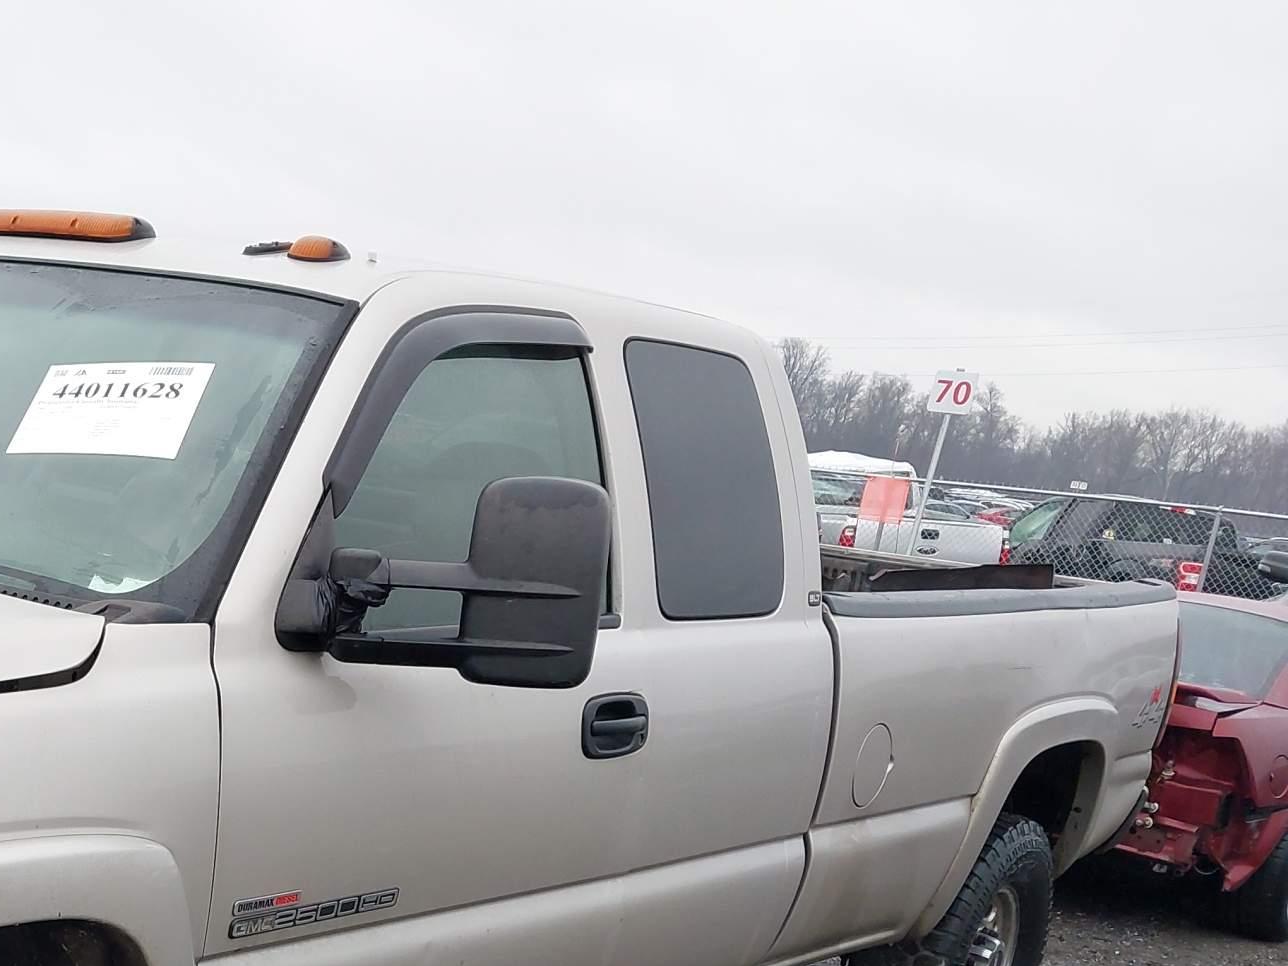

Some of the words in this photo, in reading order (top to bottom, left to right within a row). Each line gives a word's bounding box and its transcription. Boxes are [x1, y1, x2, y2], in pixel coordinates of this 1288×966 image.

[52, 382, 184, 399] 44011628
[935, 379, 972, 405] 70
[237, 897, 275, 913] DURAMAX
